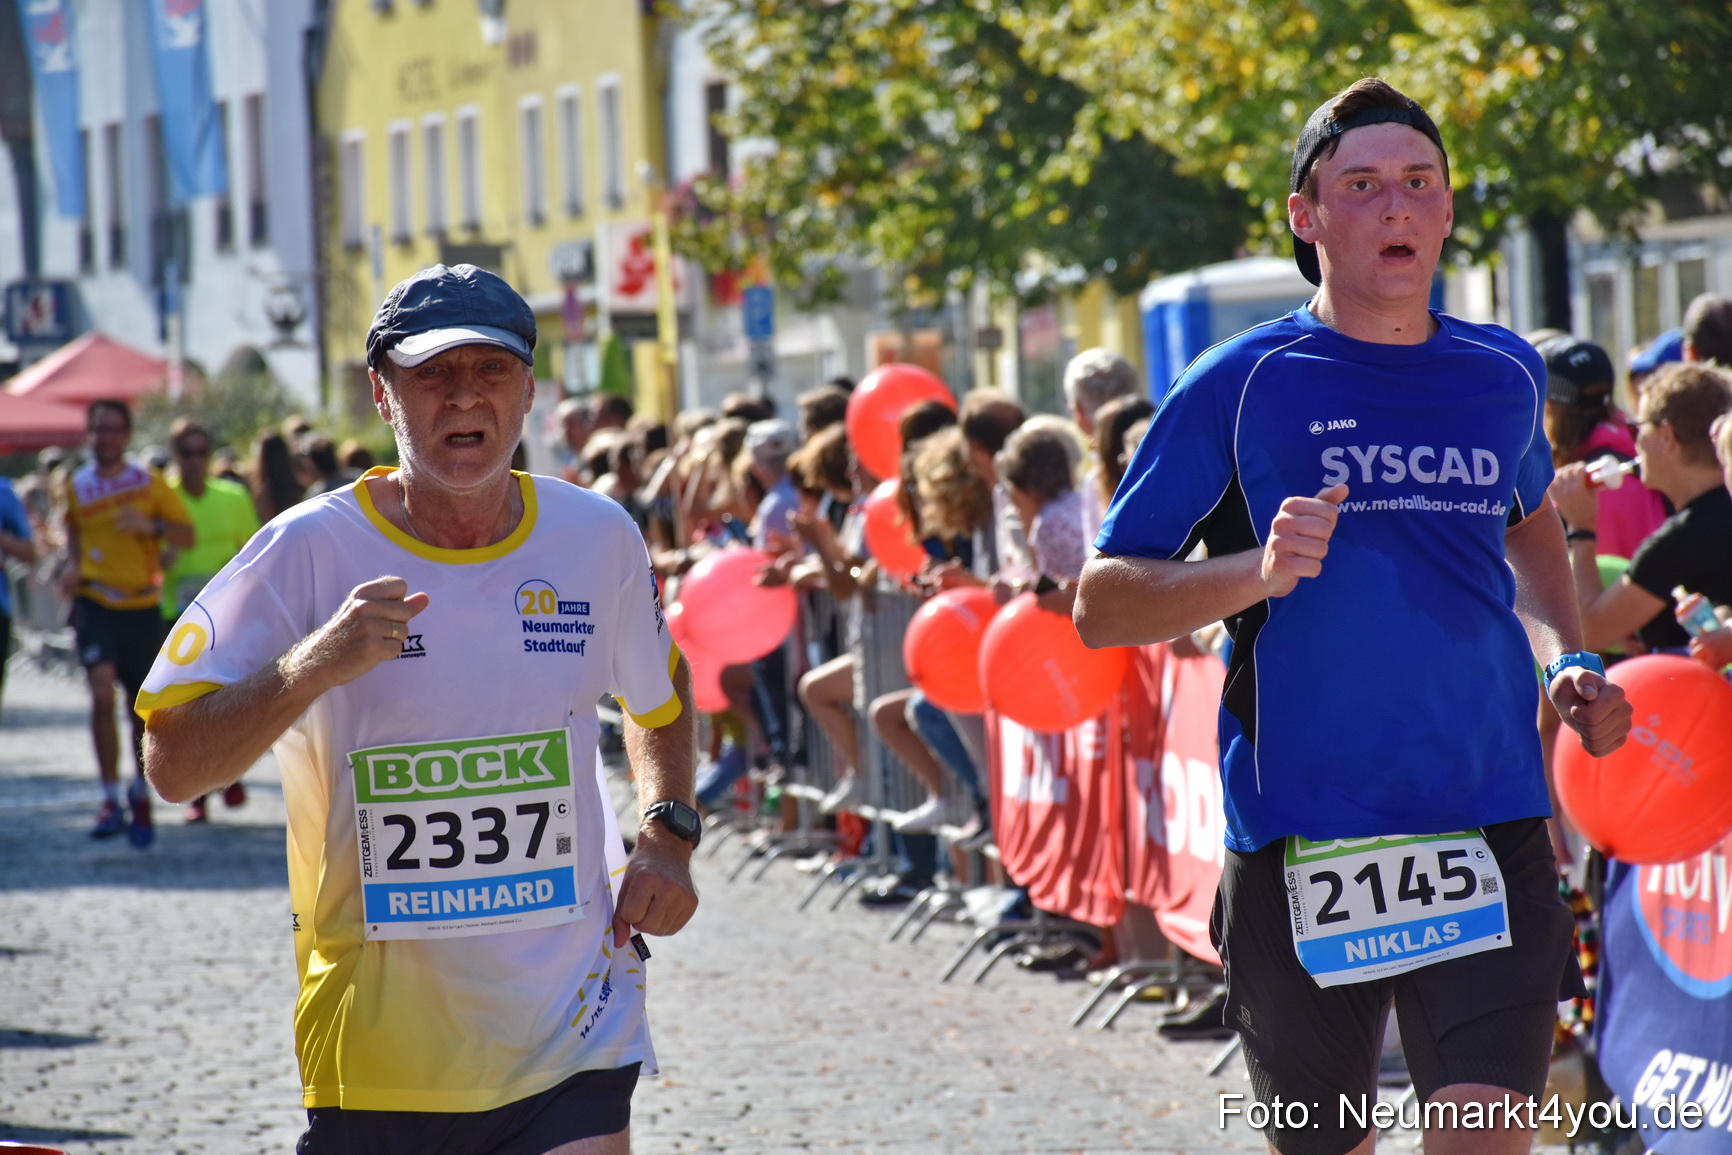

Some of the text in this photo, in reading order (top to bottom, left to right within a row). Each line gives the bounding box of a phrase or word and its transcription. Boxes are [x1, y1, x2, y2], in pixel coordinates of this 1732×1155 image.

[1327, 419, 1357, 431] JAKO
[1321, 445, 1500, 486] SYSCAD
[1336, 494, 1506, 516] ww.metallbau-cad.de
[520, 589, 588, 615] 20 JAHRE
[522, 620, 595, 635] Neumarkter
[524, 639, 586, 656] Stadtlauf
[369, 740, 554, 794] BOCK
[383, 801, 550, 871] 2337
[388, 878, 555, 916] REINHARD
[1309, 849, 1478, 926] 2145
[1344, 921, 1462, 963] NIKLAS
[1633, 1048, 1709, 1114] GET
